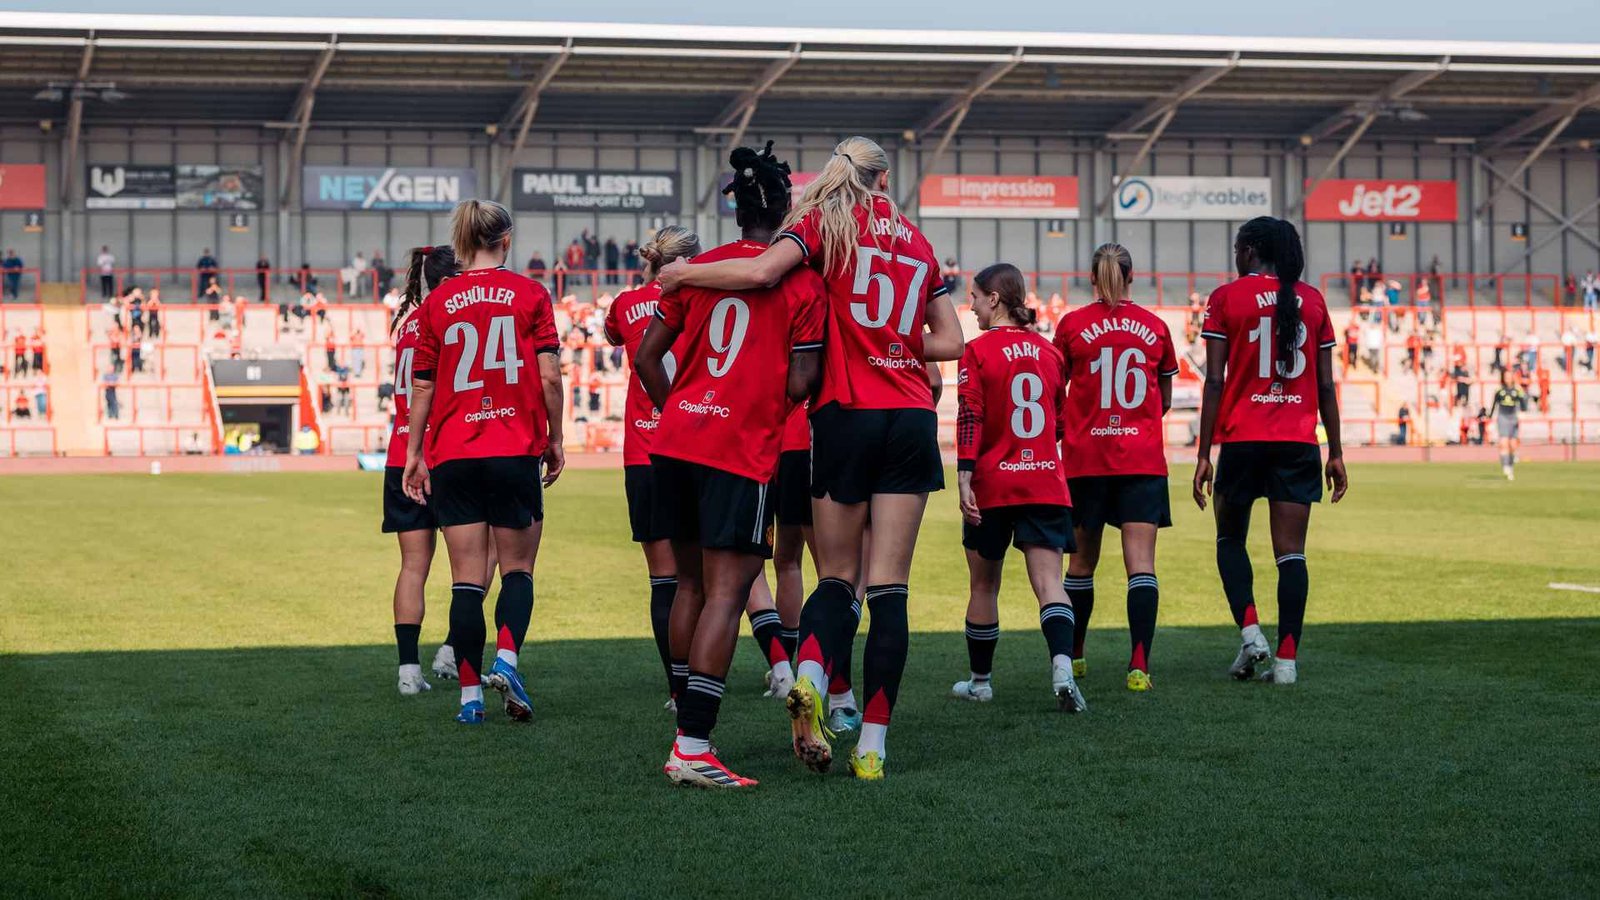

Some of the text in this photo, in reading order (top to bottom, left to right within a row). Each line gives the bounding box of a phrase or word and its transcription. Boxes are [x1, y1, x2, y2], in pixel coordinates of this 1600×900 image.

[320, 168, 460, 208] NEXGEN
[523, 174, 674, 196] PAUL LESTER
[960, 178, 1056, 200] impression
[1156, 187, 1267, 209] leighcables
[1339, 184, 1422, 216] Jet2
[553, 195, 645, 209] TRANSPORT LTD
[445, 286, 516, 315] SCHÜLLER
[850, 246, 928, 336] 57
[707, 297, 750, 378] 9
[1080, 317, 1158, 346] NAALSUND
[444, 315, 524, 393] 24
[1002, 341, 1041, 362] PARK
[1090, 347, 1148, 410] 16
[1011, 372, 1046, 439] 8
